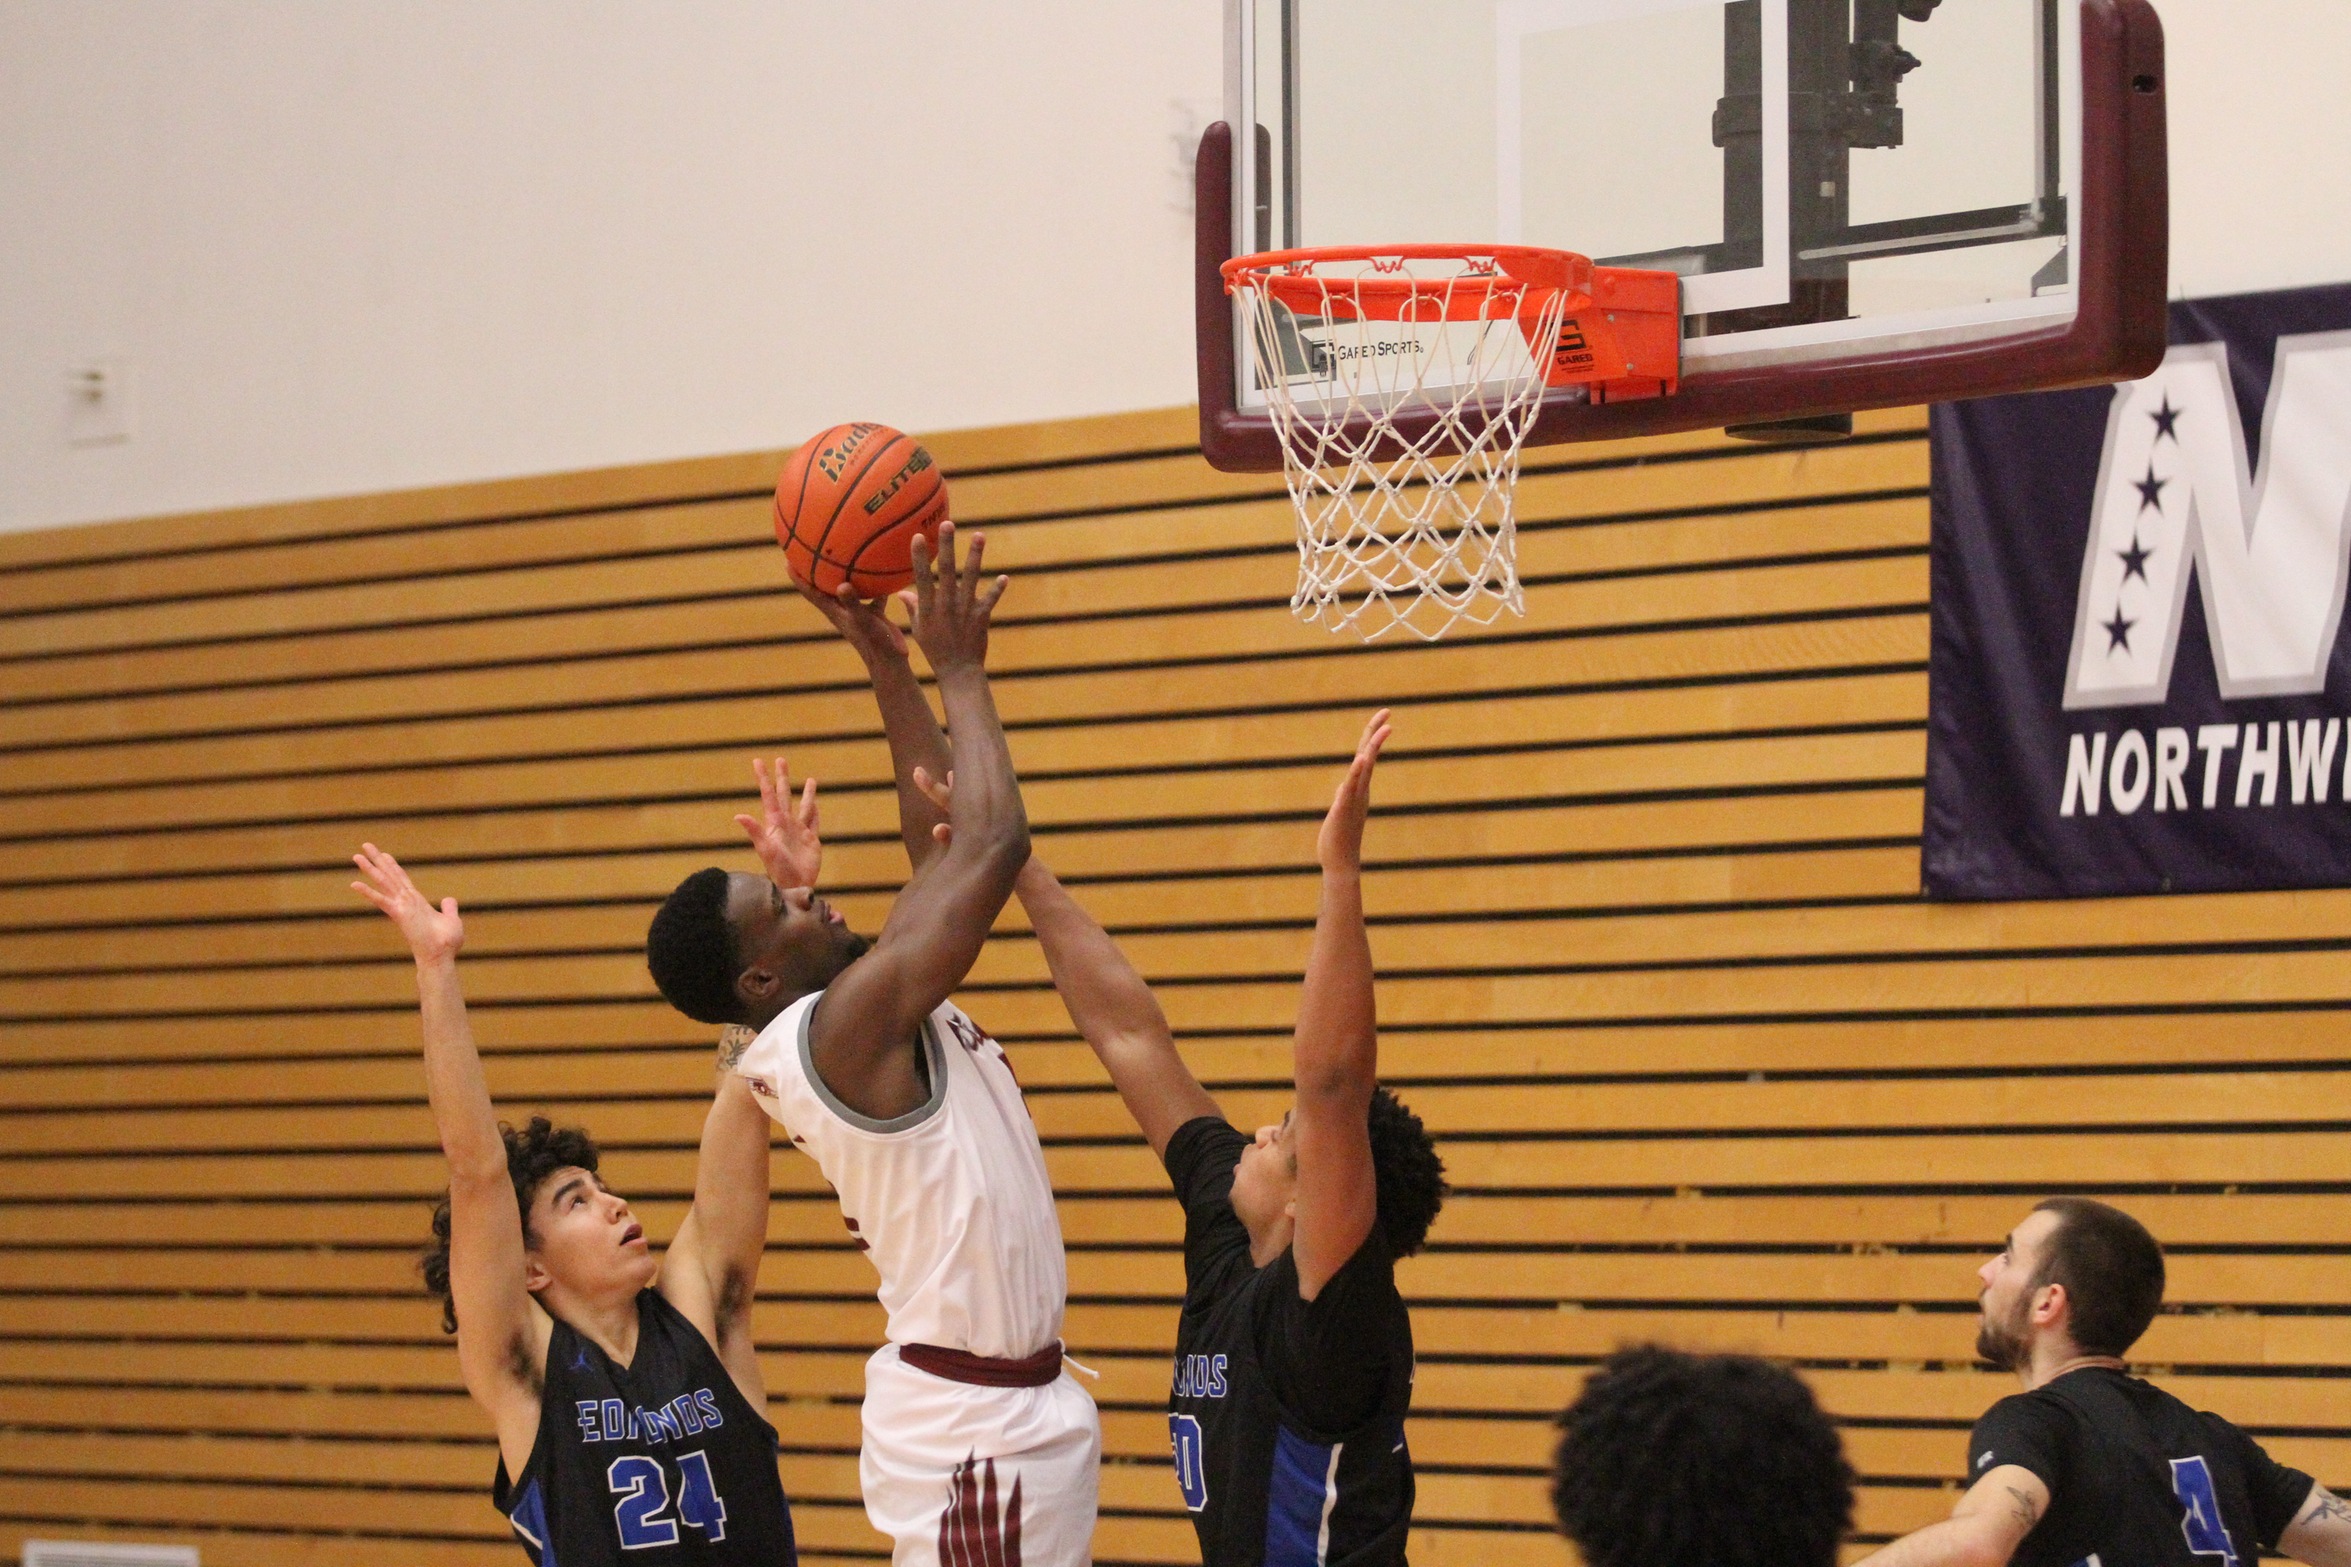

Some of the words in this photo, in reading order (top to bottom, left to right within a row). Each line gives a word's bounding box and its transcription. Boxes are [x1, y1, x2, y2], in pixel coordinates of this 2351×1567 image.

[1557, 353, 1593, 365] GARED
[863, 459, 922, 515] ELITE
[2060, 717, 2351, 817] NORTHW
[607, 1449, 728, 1550] 24
